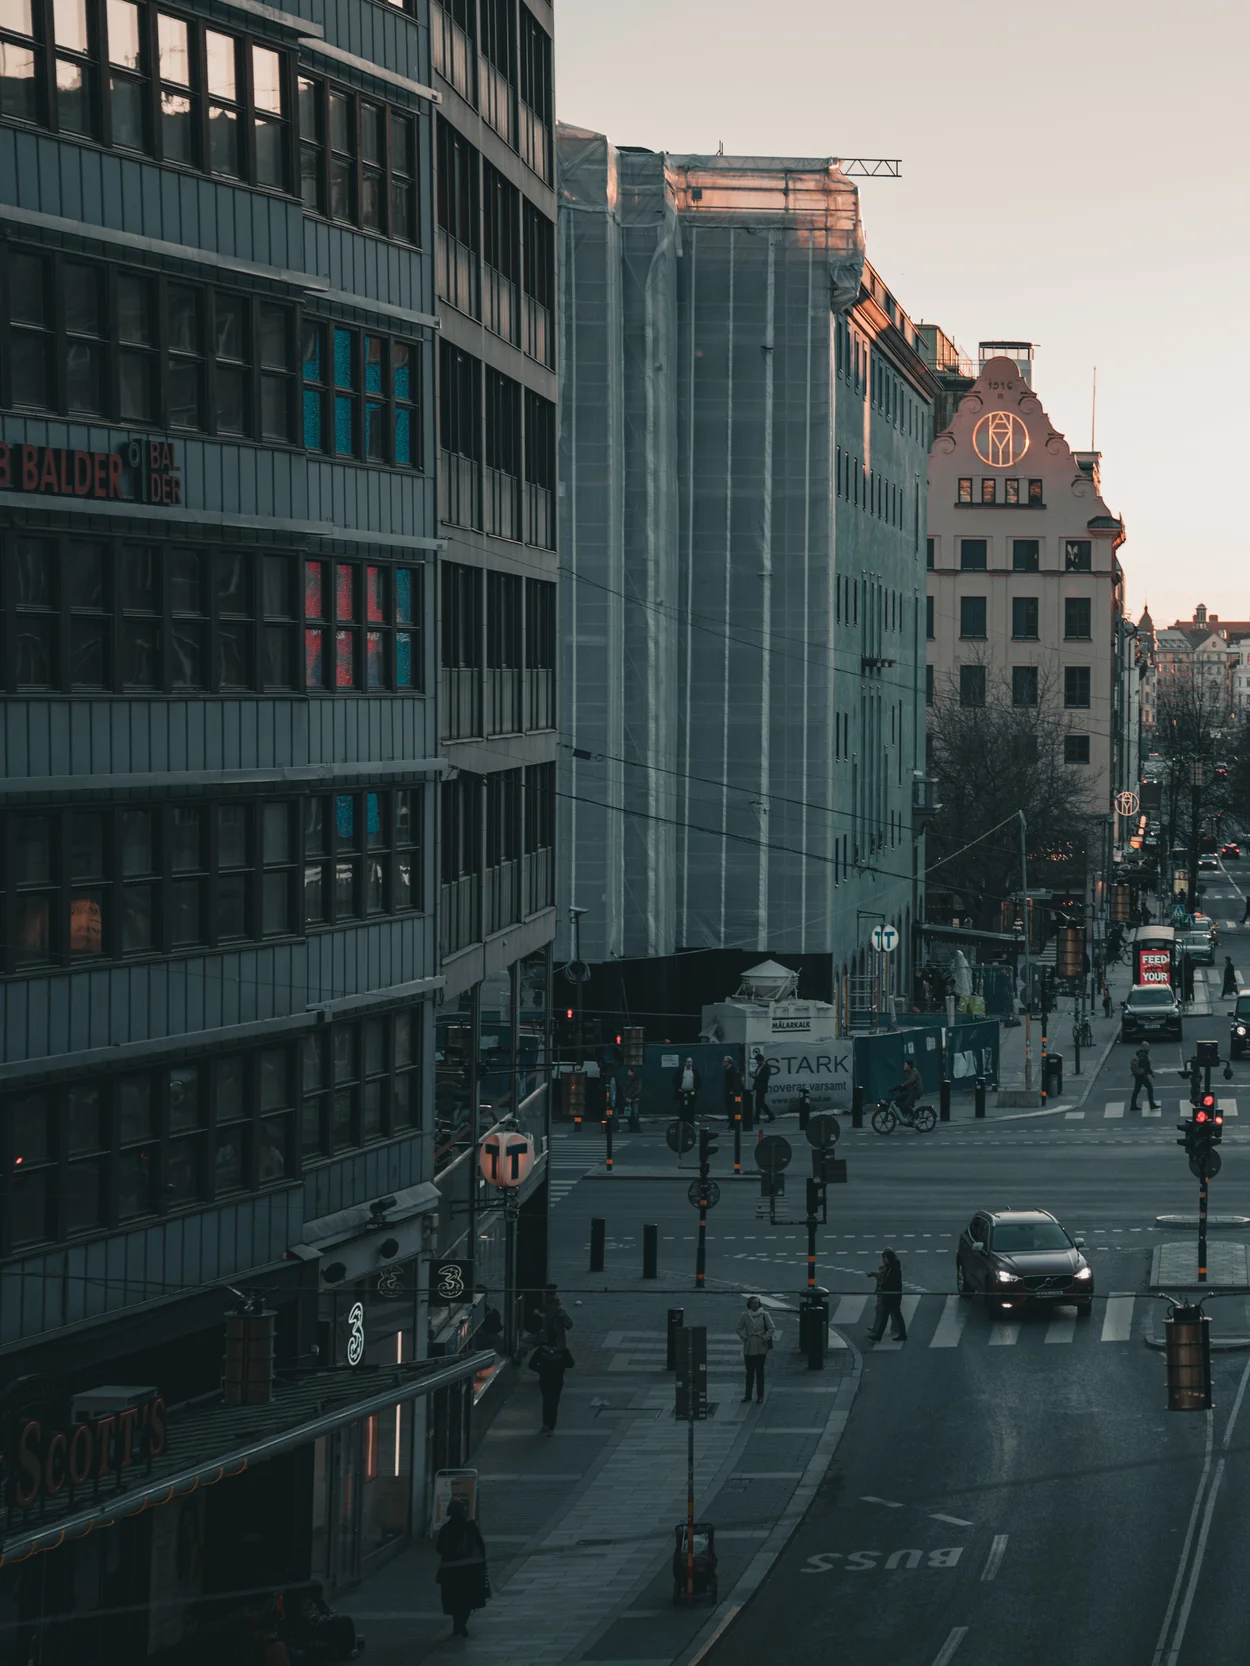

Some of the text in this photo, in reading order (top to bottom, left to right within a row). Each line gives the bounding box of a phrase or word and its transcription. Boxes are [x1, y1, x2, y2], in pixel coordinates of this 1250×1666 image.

[151, 441, 180, 471] BAL
[22, 444, 123, 499] BALDER
[151, 473, 181, 504] DER
[1142, 955, 1167, 964] FEED
[1142, 972, 1168, 981] YOUR
[765, 1055, 849, 1076] STARK
[809, 1081, 847, 1092] varsamt
[800, 1547, 964, 1573] BUSS
